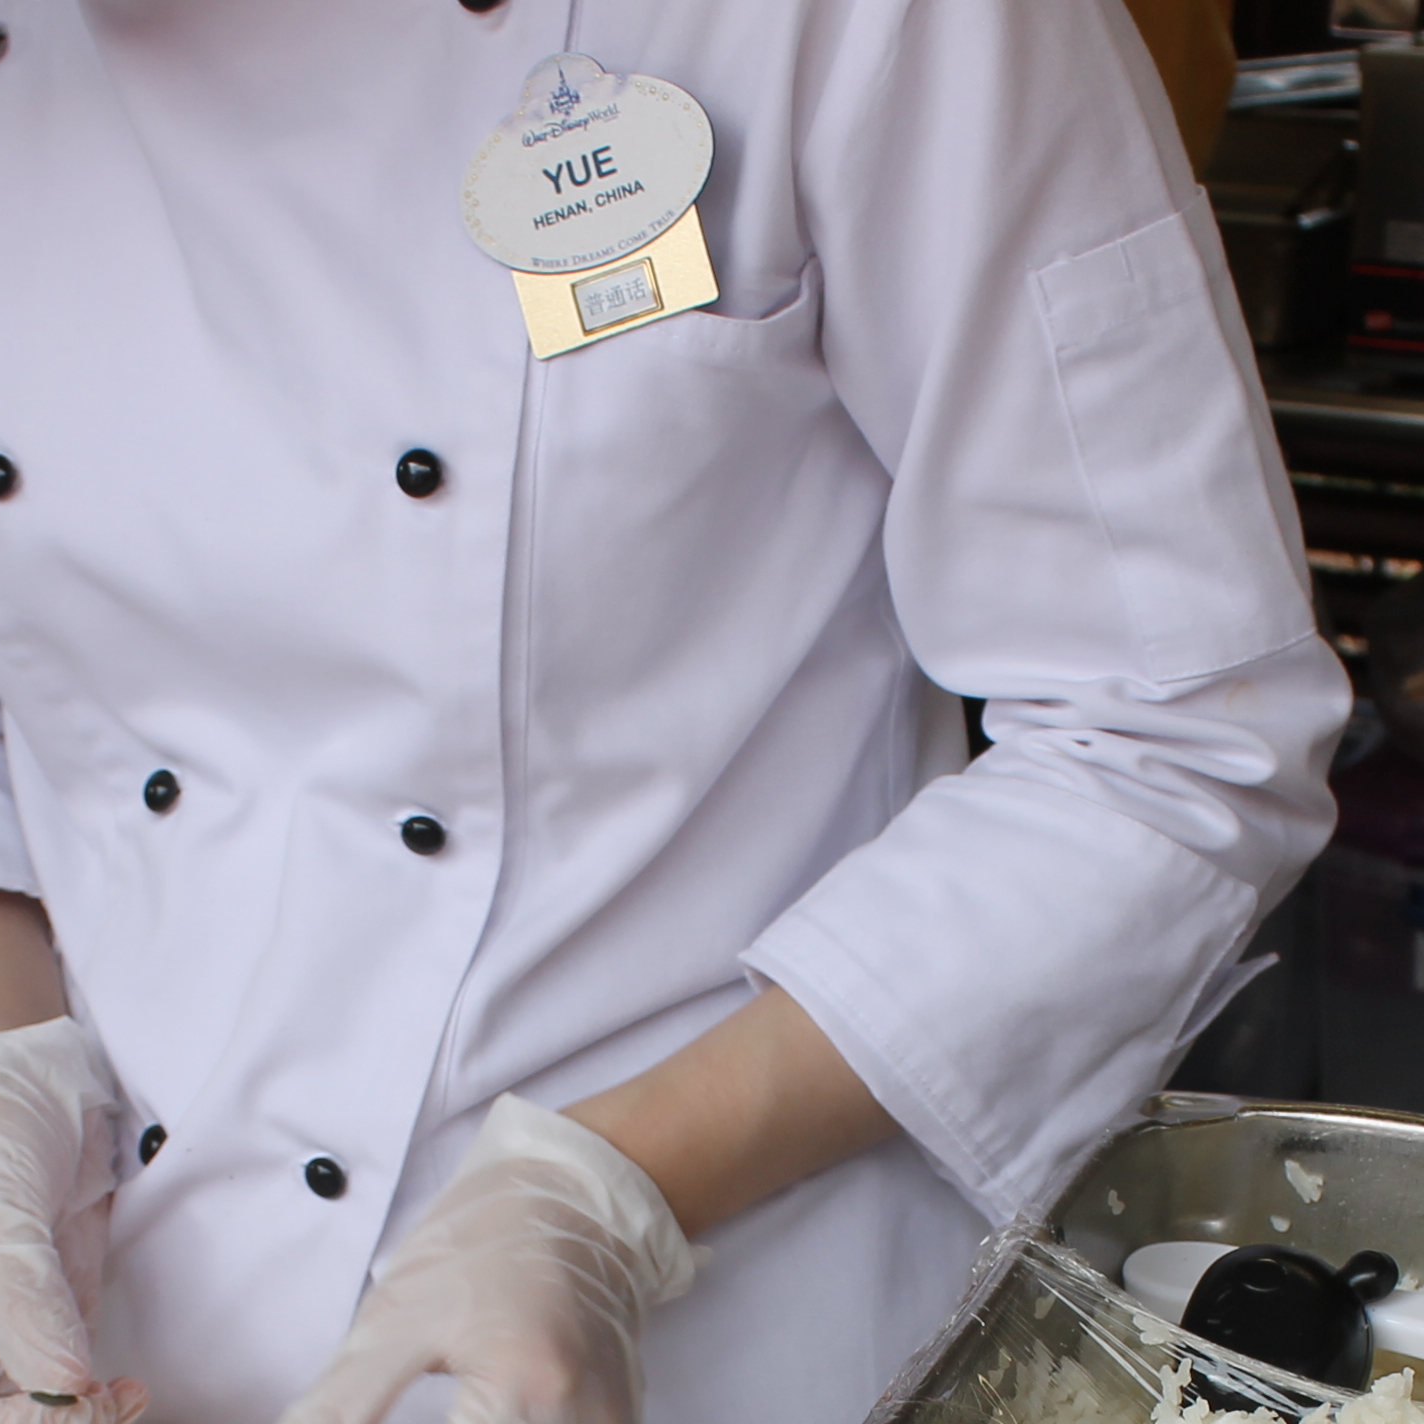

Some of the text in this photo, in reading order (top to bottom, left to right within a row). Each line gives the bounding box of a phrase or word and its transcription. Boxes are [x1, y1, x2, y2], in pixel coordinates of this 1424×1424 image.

[588, 102, 620, 123] World
[541, 144, 618, 197] YUE
[532, 178, 645, 231] HENAN, CHINA
[616, 228, 647, 251] COME
